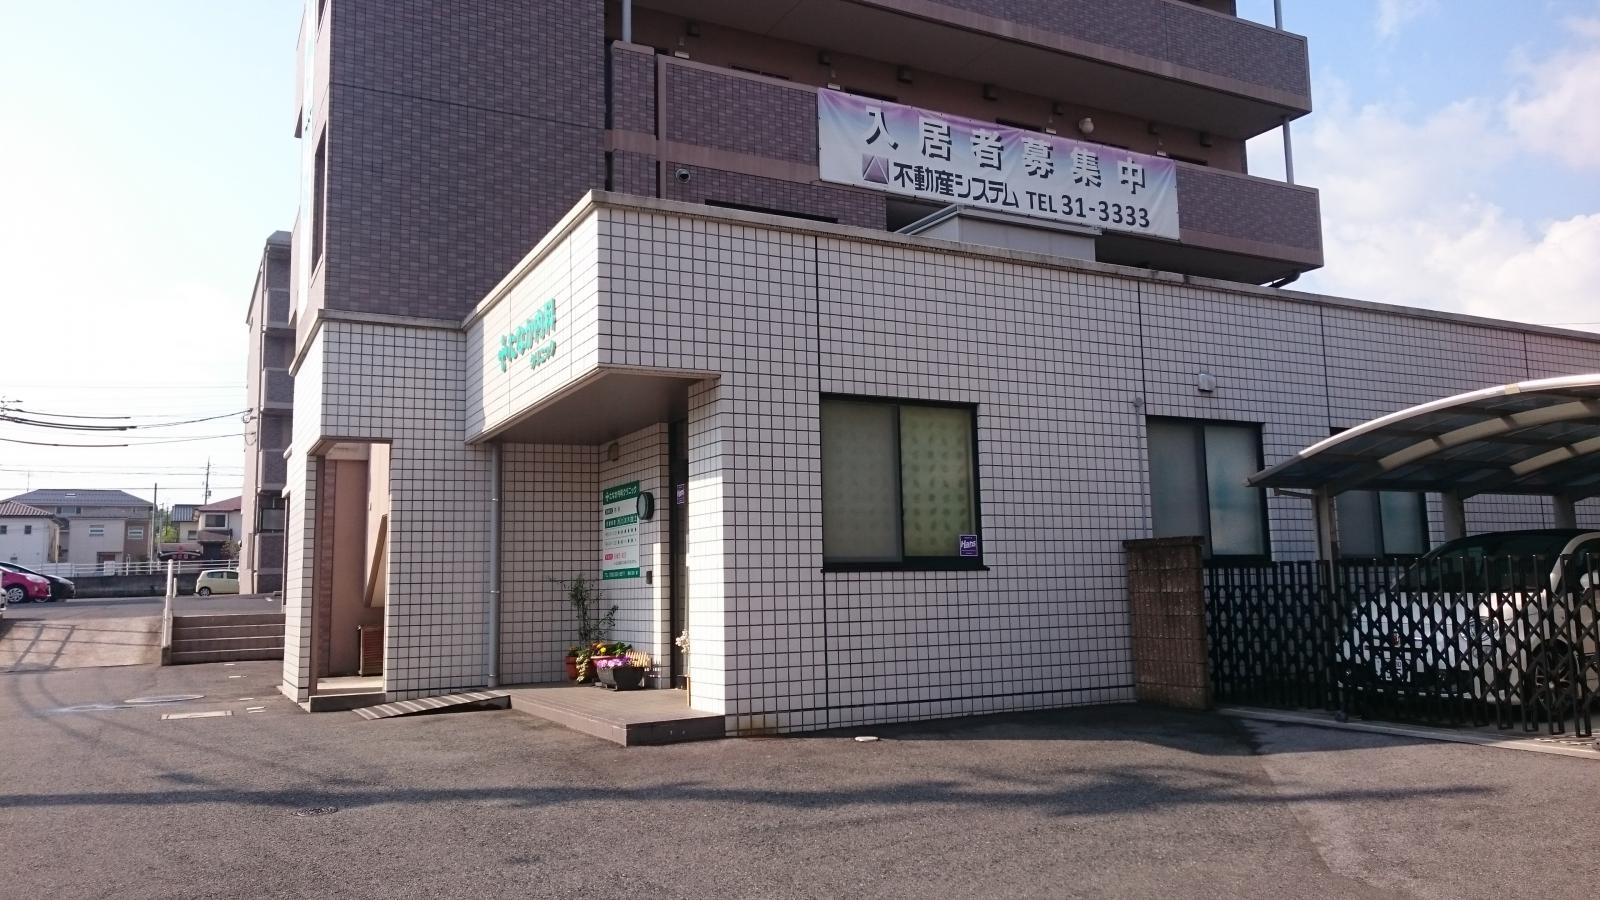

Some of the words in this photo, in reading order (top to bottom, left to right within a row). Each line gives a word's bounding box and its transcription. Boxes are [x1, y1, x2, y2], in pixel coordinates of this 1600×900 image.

[865, 105, 1147, 195] 入居者募集中
[893, 160, 1020, 209] 不動産システム
[1025, 191, 1058, 214] TEL
[1062, 194, 1150, 228] 31-3333
